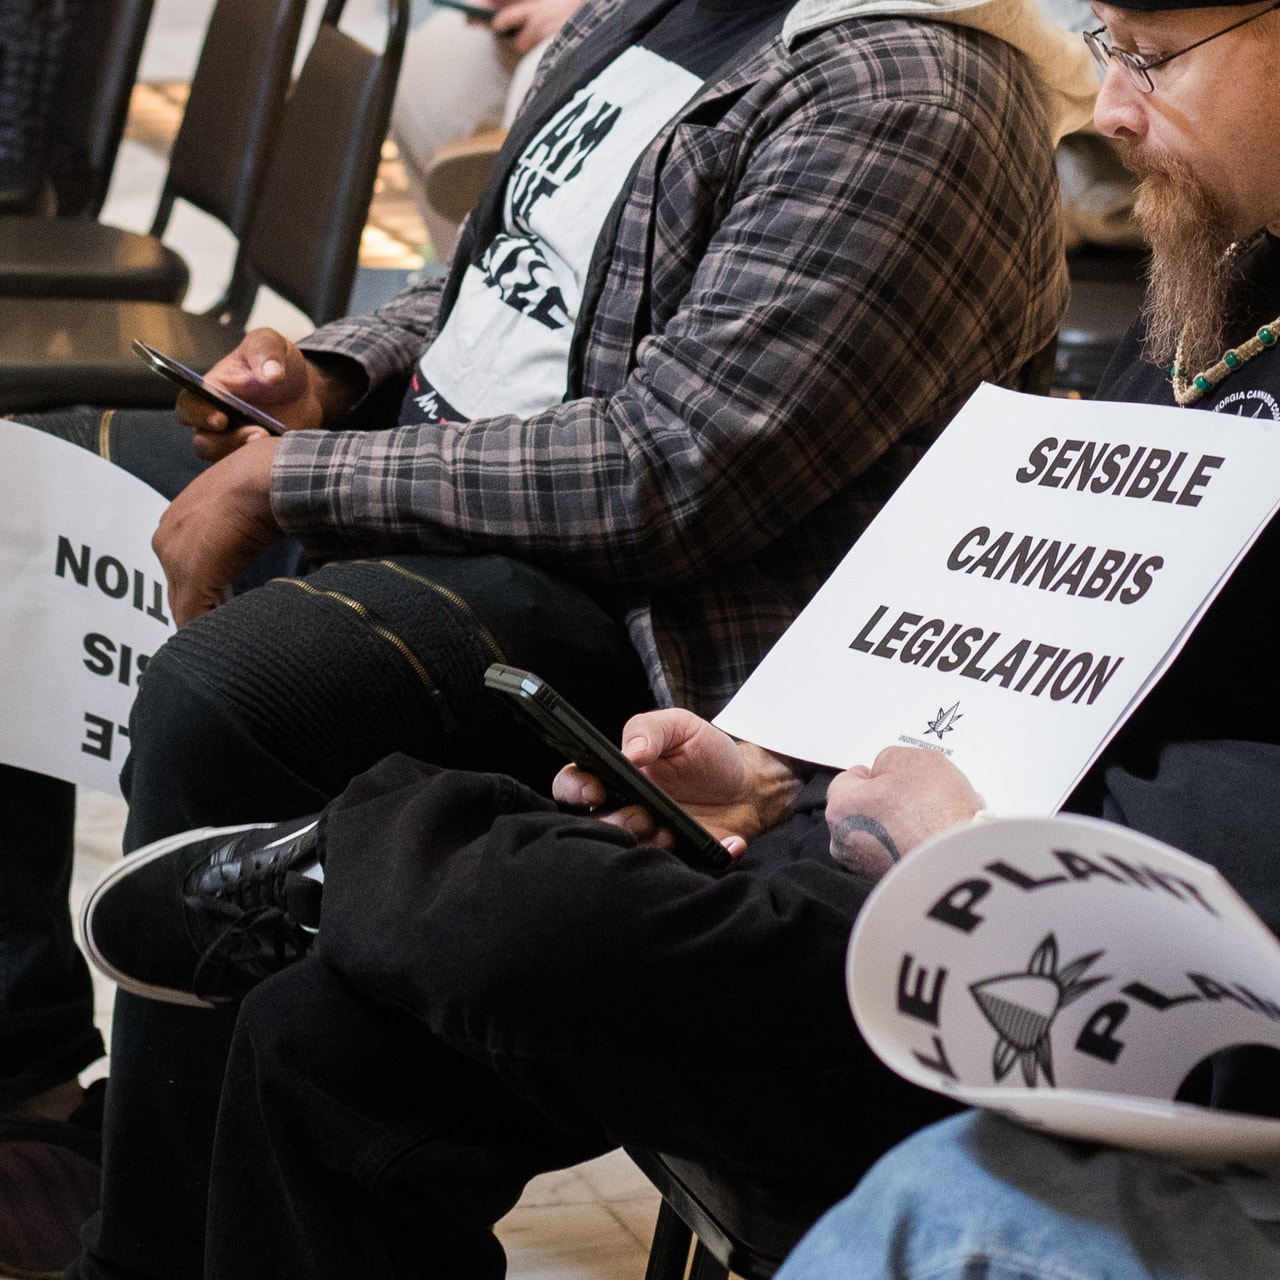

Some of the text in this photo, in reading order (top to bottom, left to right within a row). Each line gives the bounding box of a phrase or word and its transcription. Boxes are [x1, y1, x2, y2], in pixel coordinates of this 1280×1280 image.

[1212, 391, 1245, 413] EORGIA
[1016, 436, 1225, 508] SENSIBLE
[946, 526, 1164, 605] CANNABIS
[848, 605, 1124, 706] LEGISLATION
